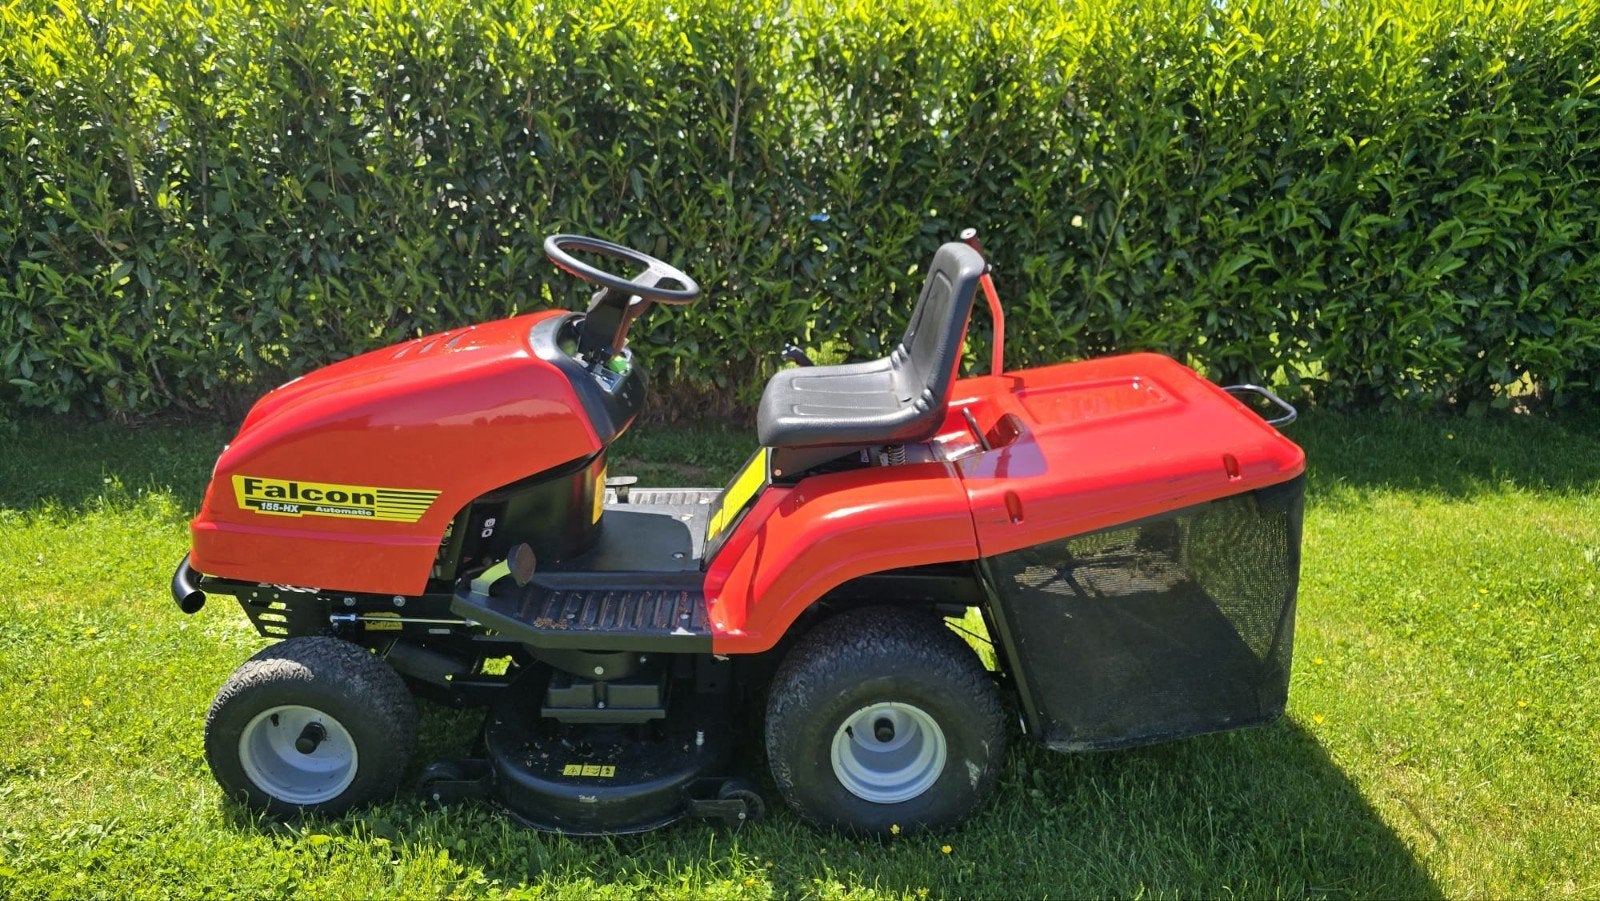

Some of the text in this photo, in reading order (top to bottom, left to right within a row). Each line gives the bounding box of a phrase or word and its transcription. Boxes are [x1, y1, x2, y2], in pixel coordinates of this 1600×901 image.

[244, 478, 375, 505] Falcon
[260, 502, 372, 516] 155-HX Automatic
